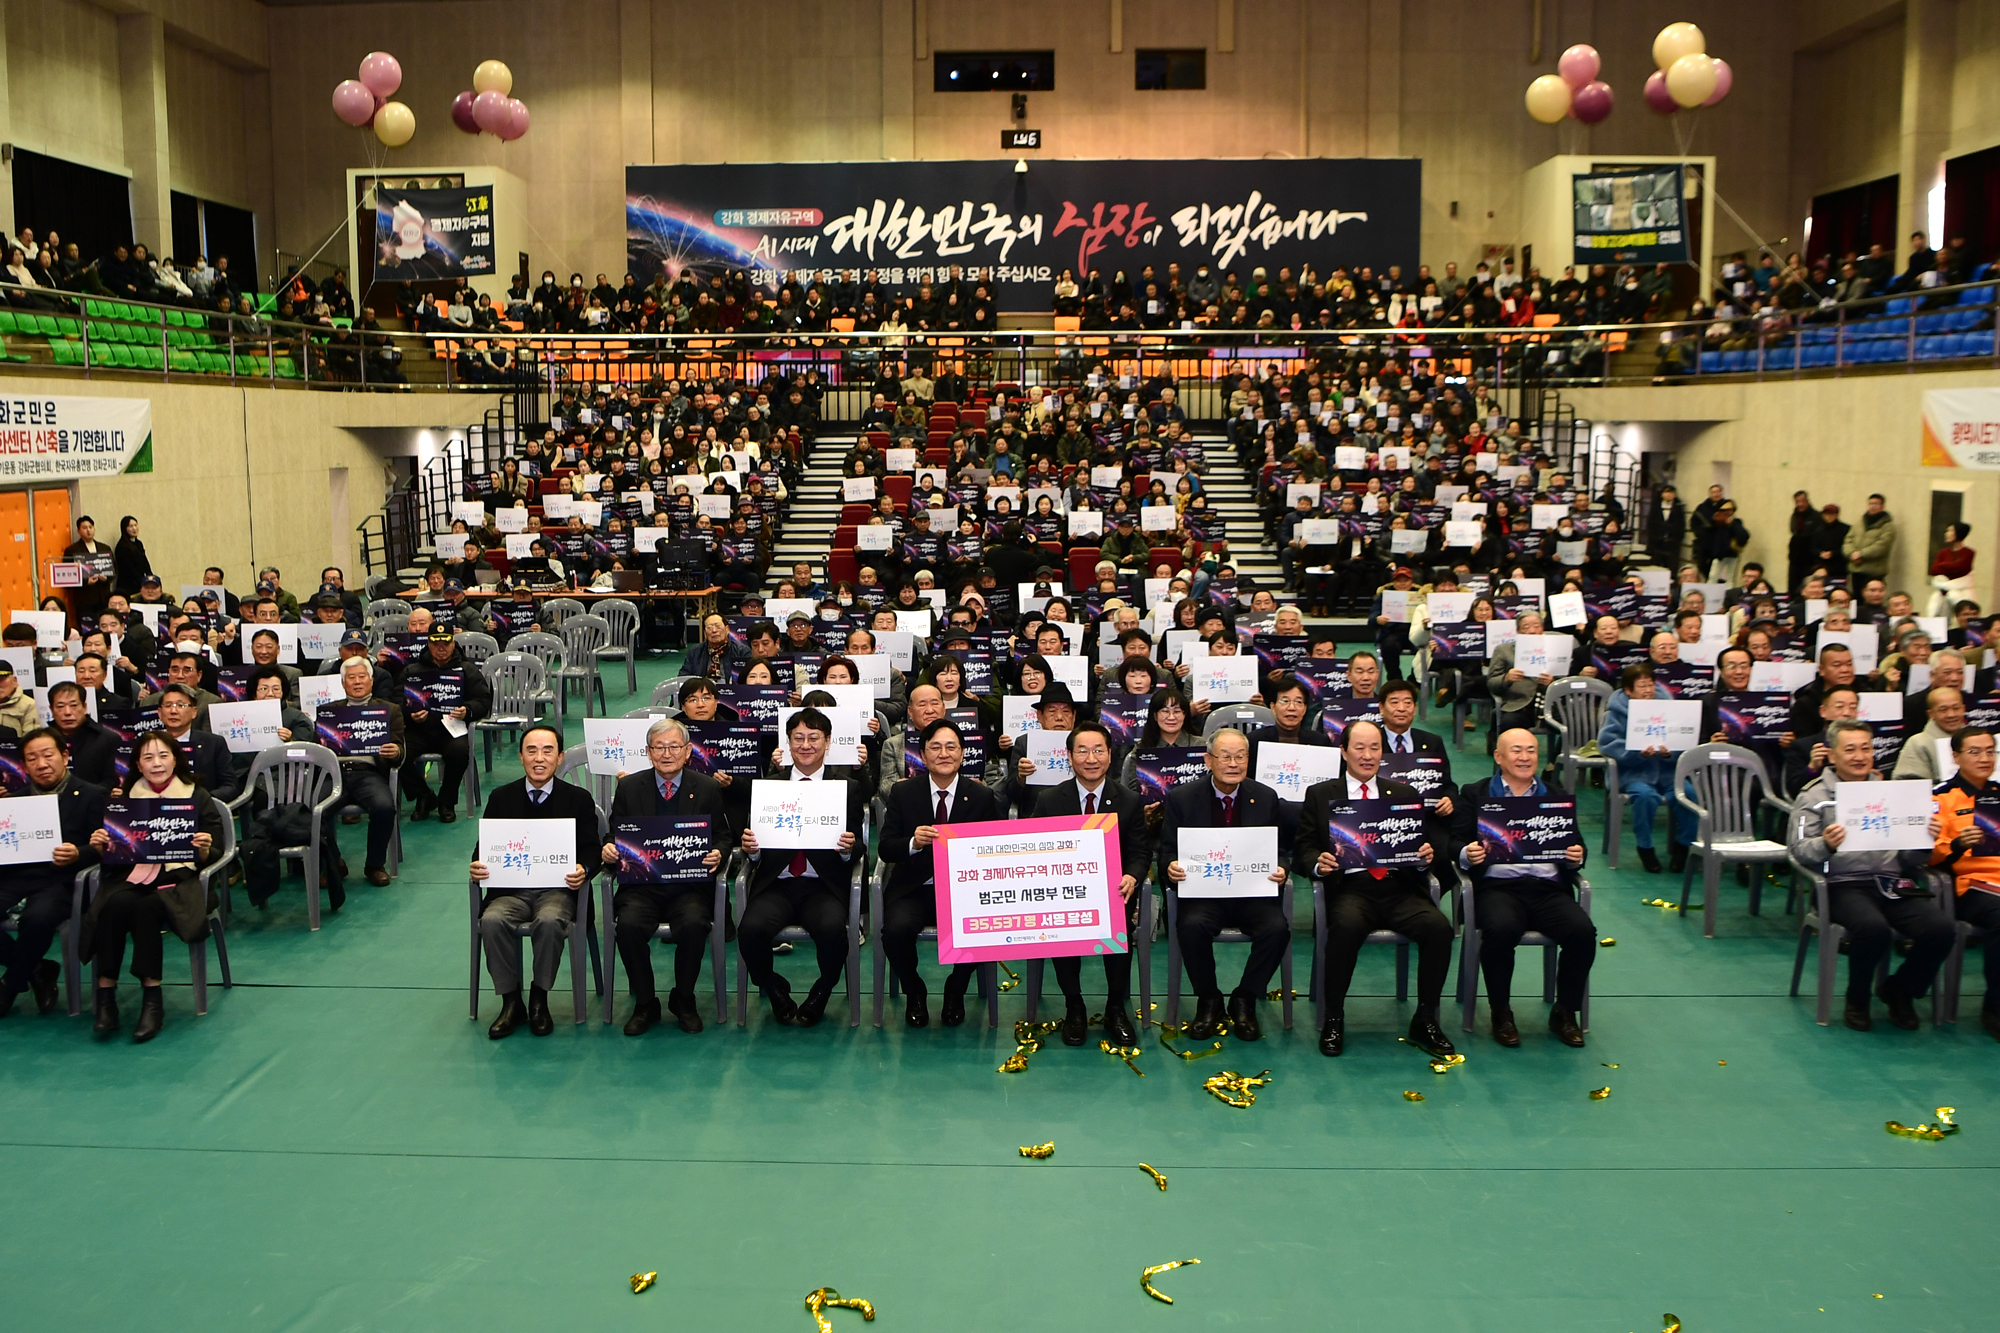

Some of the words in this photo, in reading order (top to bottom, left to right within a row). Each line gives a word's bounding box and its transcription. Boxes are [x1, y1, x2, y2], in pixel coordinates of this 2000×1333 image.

[431, 214, 489, 232] 경제자유구역
[721, 211, 744, 225] 강화
[747, 210, 815, 225] 경제자유구역
[751, 234, 777, 264] AI
[778, 235, 819, 258] 시대
[823, 198, 1043, 264] 대한민국의
[1052, 201, 1163, 278] 심장이
[1170, 190, 1368, 270] 되겠습니다
[751, 268, 778, 285] 강화
[997, 266, 1051, 282] 주십시오
[35, 429, 69, 454] 신축을
[72, 430, 125, 453] 기원합니다
[1070, 679, 1083, 687] 인천
[839, 736, 855, 745] 인천
[603, 747, 625, 765] 초일류
[640, 748, 647, 756] 인
[1276, 771, 1300, 792] 초일류
[780, 801, 803, 813] 행복한
[148, 817, 194, 831] 대한민국의
[758, 816, 774, 824] 세계
[774, 814, 803, 836] 초일류
[804, 817, 819, 825] 도시
[820, 816, 839, 826] 인천
[1377, 818, 1422, 831] 대한민국의
[20, 831, 34, 839] 도시
[35, 829, 54, 839] 인천
[151, 829, 195, 846] 되겠습니다
[661, 835, 708, 848] 대한민국의
[1381, 829, 1423, 848] 되겠습니다
[507, 837, 531, 852] 행복한
[996, 842, 1036, 853] 대한민국의
[1039, 841, 1054, 851] 심장
[486, 855, 502, 864] 세계
[502, 851, 532, 875] 초일류
[532, 856, 548, 864] 도시
[549, 854, 569, 864] 인천
[665, 847, 709, 864] 되겠습니다
[1207, 848, 1232, 862] 행복한
[957, 868, 979, 883] 강화
[982, 865, 1048, 881] 경제자유구역
[1051, 863, 1073, 876] 지정
[1076, 861, 1098, 874] 추진
[1186, 865, 1202, 873] 세계
[1203, 861, 1233, 885] 초일류
[1234, 865, 1250, 873] 도시
[1250, 863, 1270, 873] 인천
[979, 890, 1016, 905] 범군민
[1021, 887, 1058, 902] 서명부
[1062, 885, 1087, 900] 전달
[969, 916, 1020, 931] 35,537
[1024, 915, 1036, 928] 명
[1041, 912, 1066, 927] 서명
[1068, 910, 1093, 925] 달성
